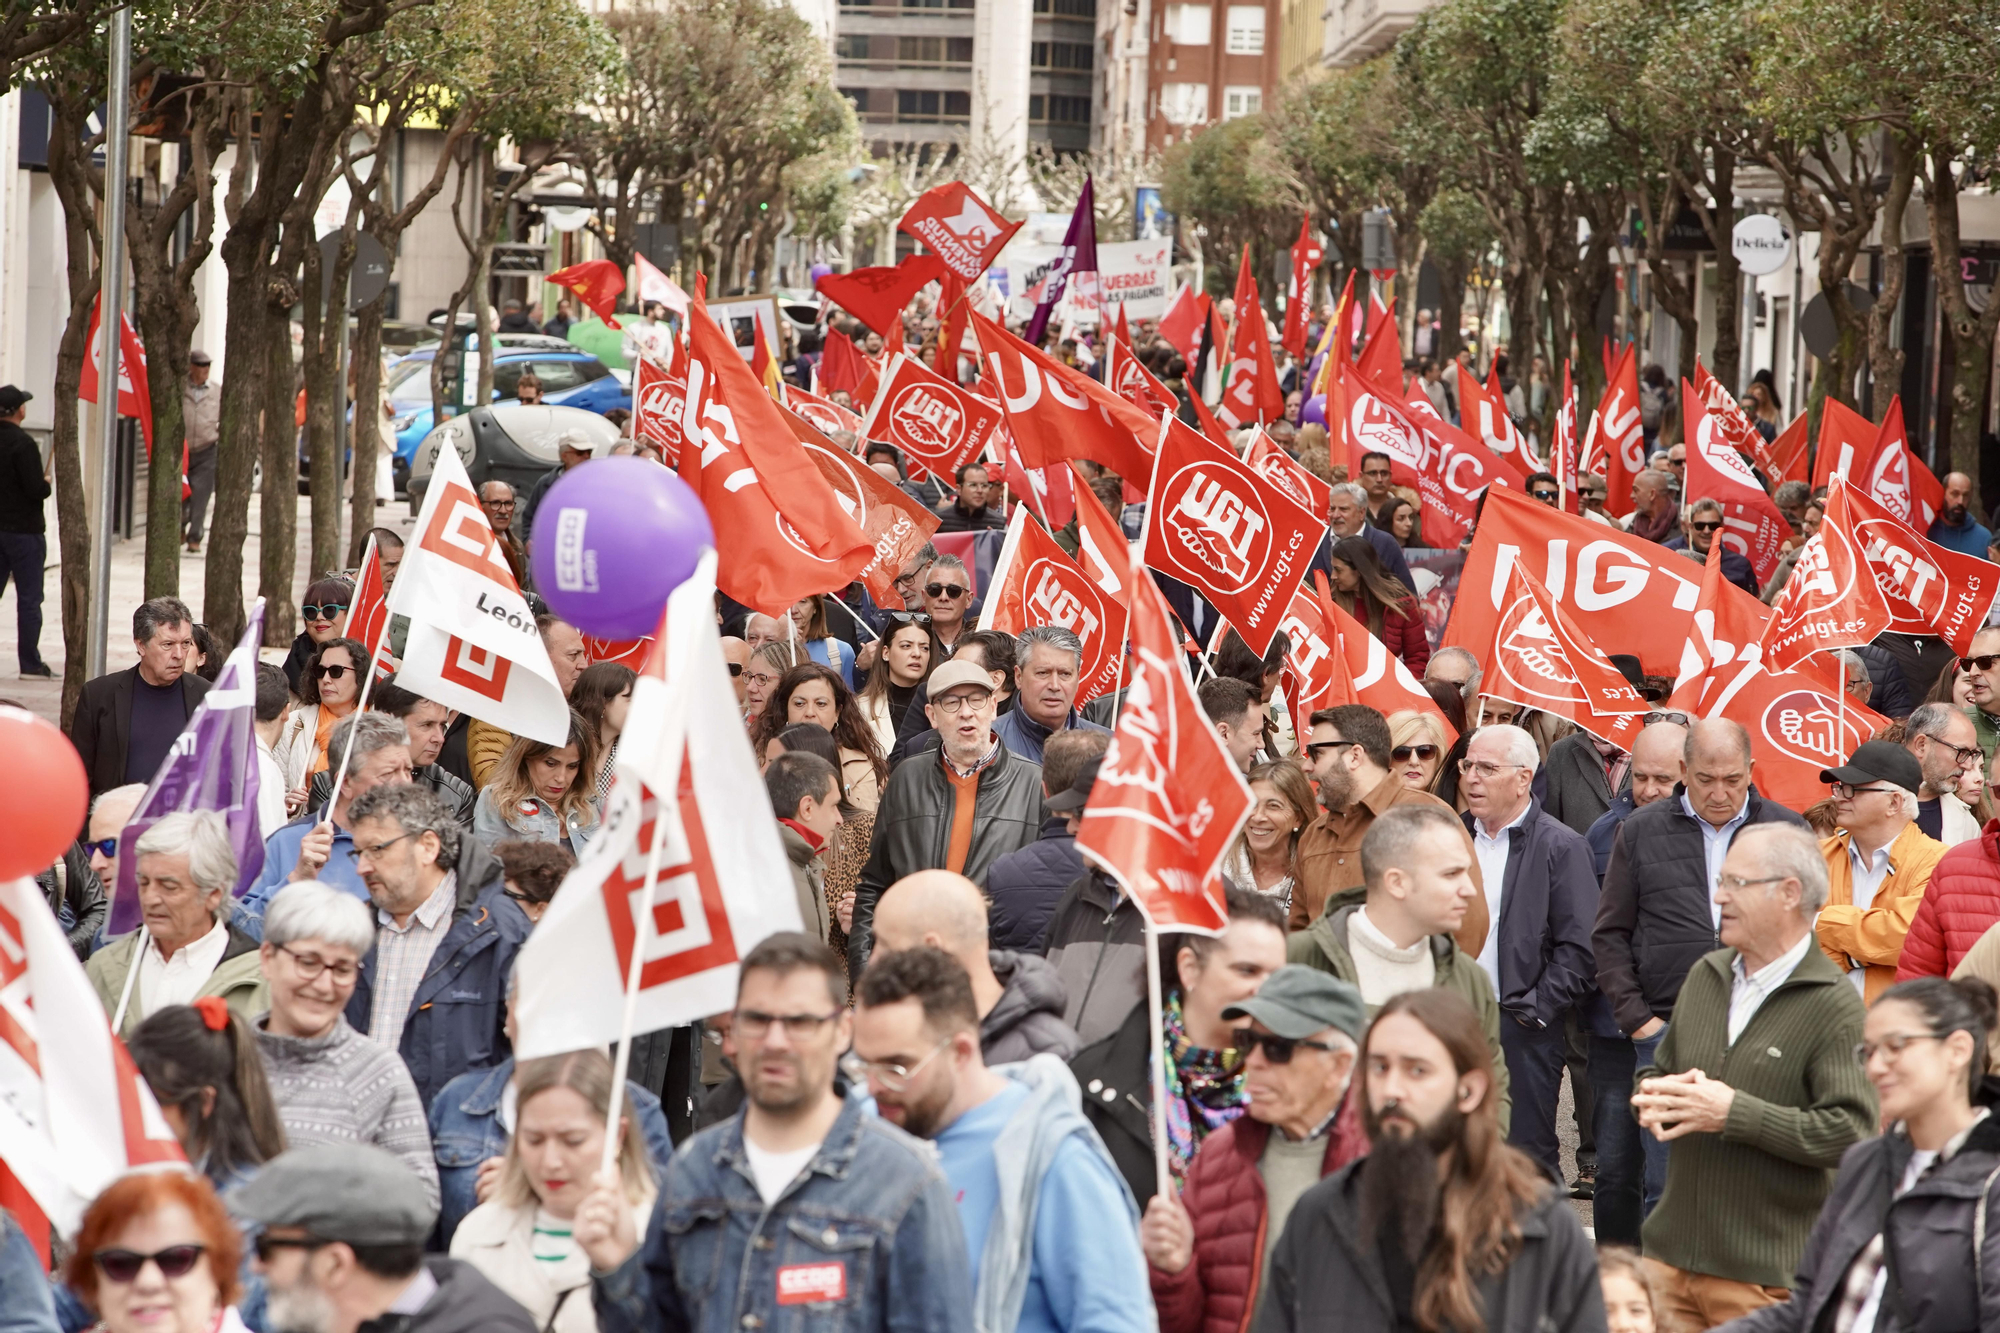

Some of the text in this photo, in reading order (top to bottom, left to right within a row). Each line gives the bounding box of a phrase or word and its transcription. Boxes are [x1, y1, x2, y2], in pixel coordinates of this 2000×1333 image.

[1736, 237, 1785, 249] Delicia
[643, 387, 685, 424] UG
[903, 388, 961, 437] UGT
[1604, 388, 1645, 474] UG
[950, 417, 987, 473] www.ugt.es
[1180, 471, 1265, 562] UGT
[860, 517, 911, 578] w.ugt.es
[1035, 566, 1099, 650] UGT
[1247, 529, 1304, 629] www.ugt.es
[475, 592, 538, 637] León
[1769, 617, 1867, 656] ww.ugt.es
[1279, 616, 1331, 690] GT
